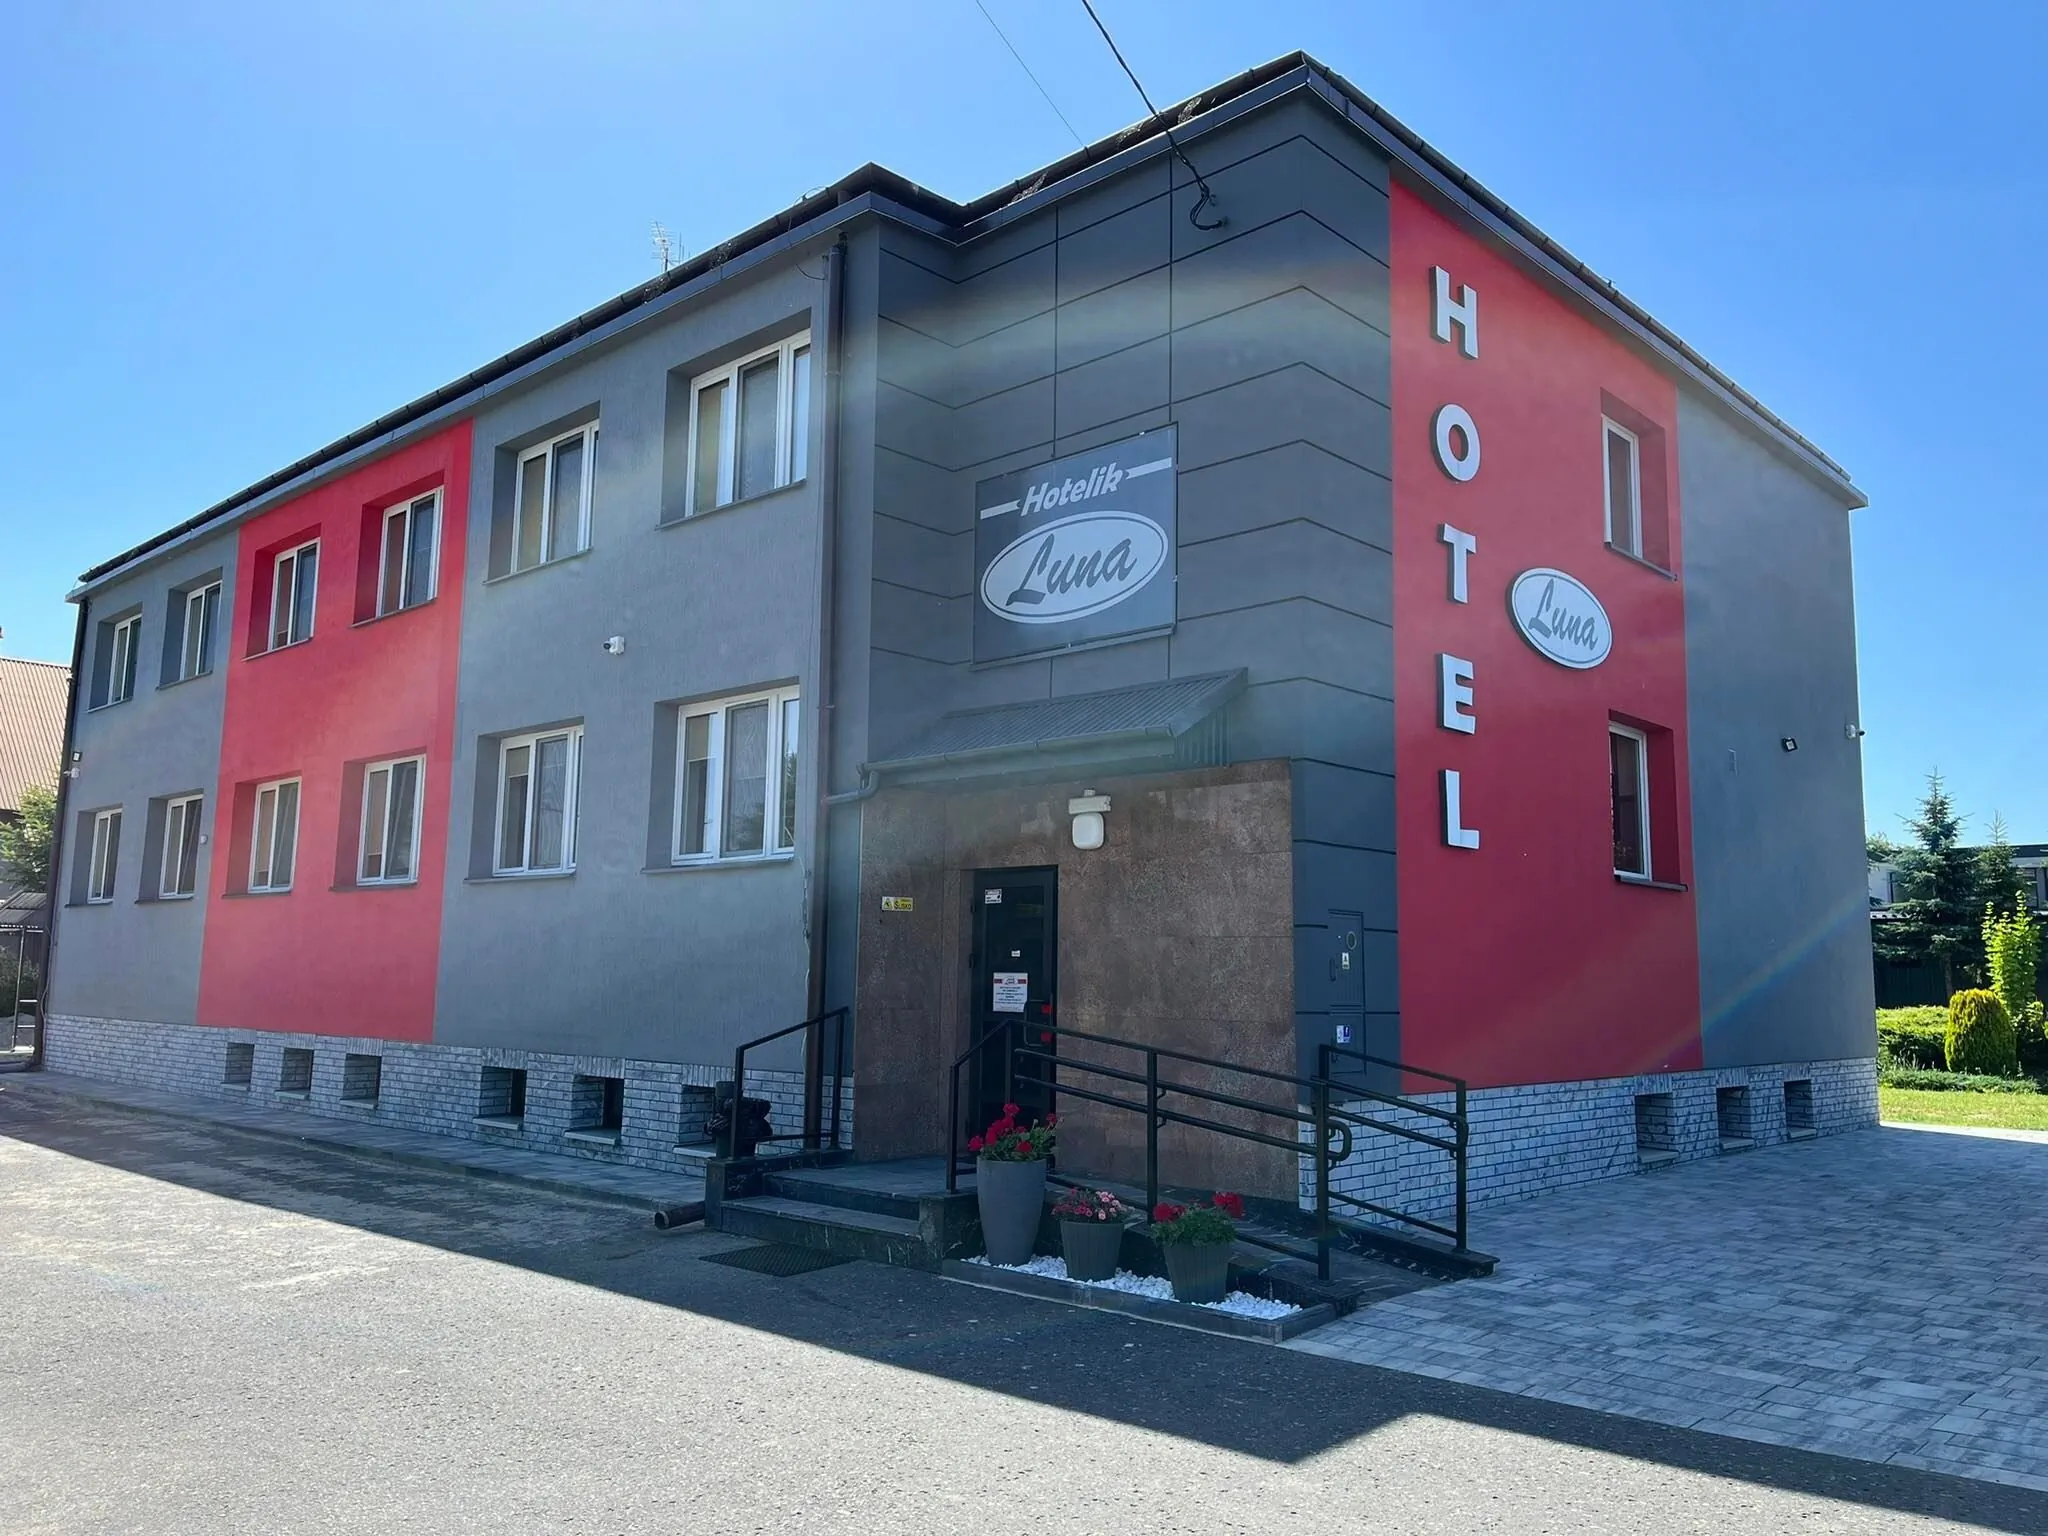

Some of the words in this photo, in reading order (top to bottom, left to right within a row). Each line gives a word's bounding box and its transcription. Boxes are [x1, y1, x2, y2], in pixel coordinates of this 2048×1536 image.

[1020, 462, 1123, 517] Hotelik
[1005, 533, 1138, 607] Luna
[1431, 265, 1481, 850] HOTEL
[1527, 578, 1599, 651] Luna
